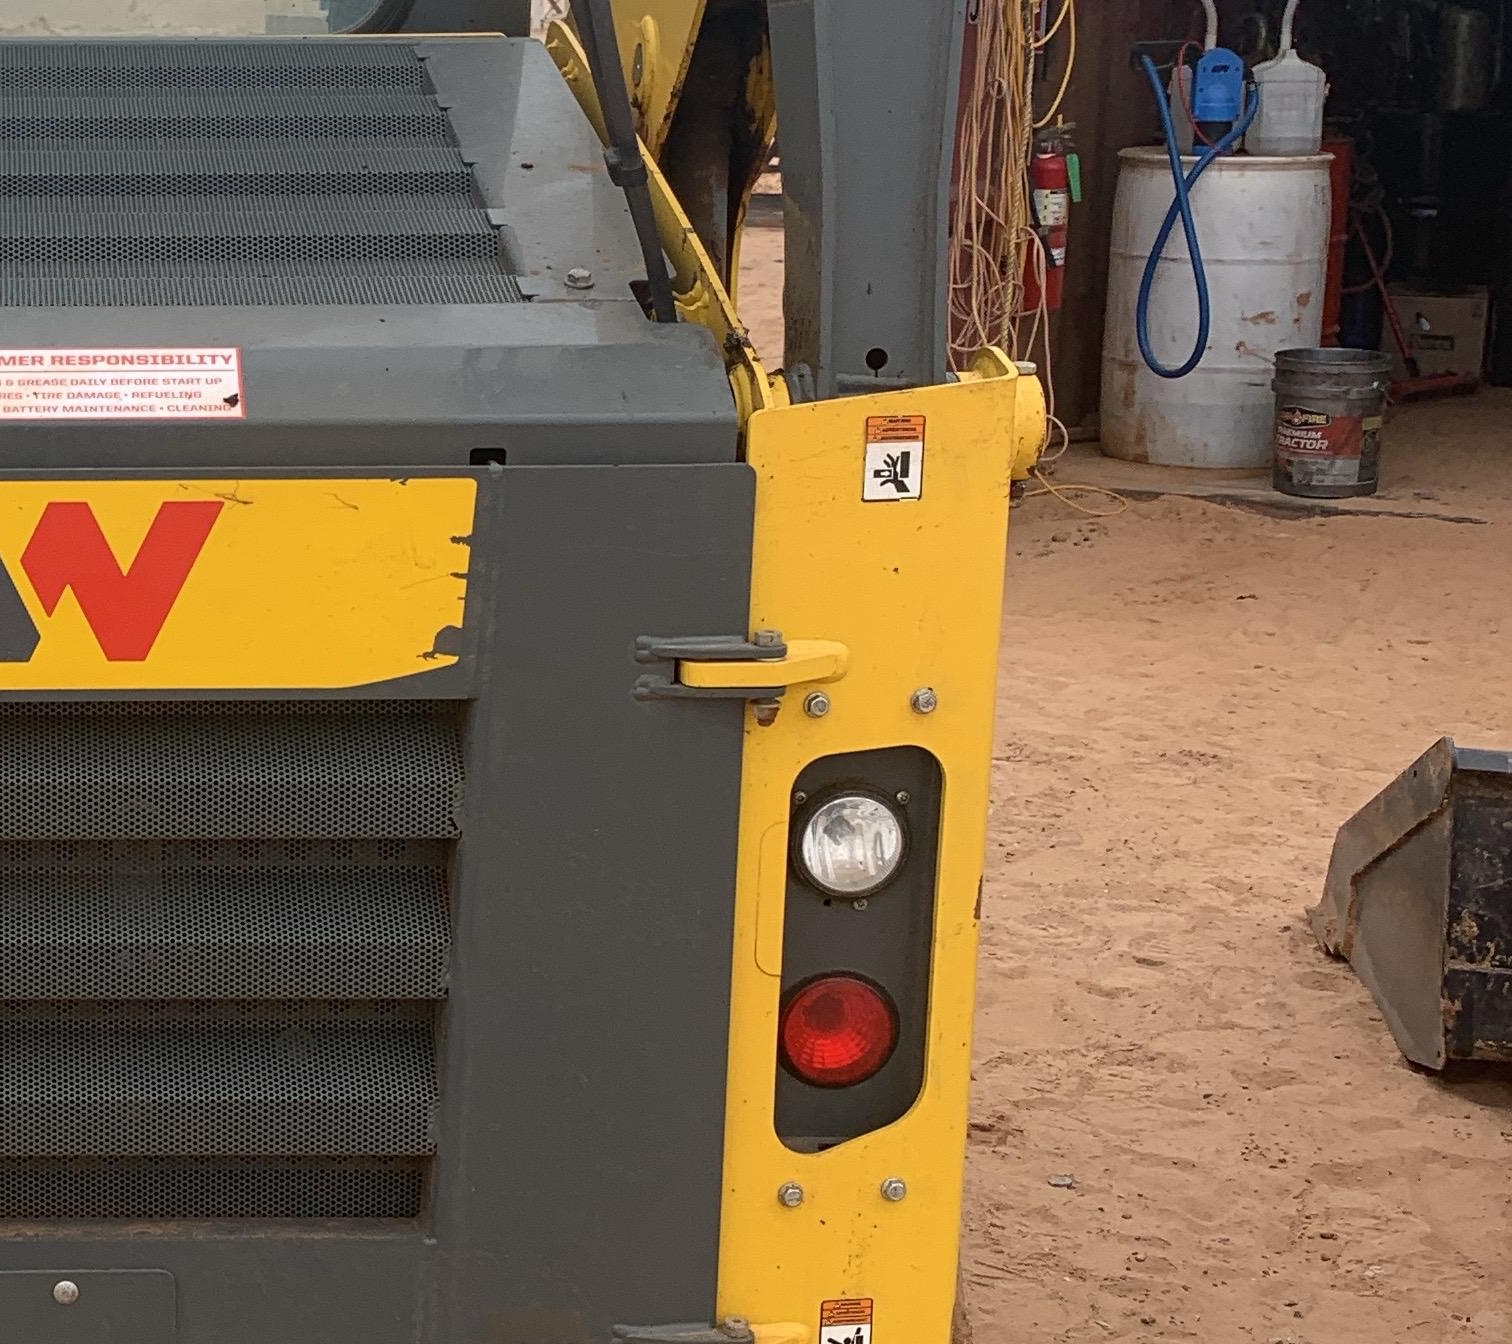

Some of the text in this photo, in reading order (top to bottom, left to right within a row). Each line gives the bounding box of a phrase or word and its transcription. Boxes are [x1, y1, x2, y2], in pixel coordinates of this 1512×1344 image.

[51, 354, 233, 366] RESPONSIBILITY
[18, 378, 66, 387] GREASE
[70, 378, 106, 387] DAILY
[110, 378, 157, 386] BEFORE
[162, 377, 201, 386] START
[205, 377, 223, 386] UP
[33, 391, 63, 400] TIRE
[67, 391, 121, 400] DAMAGE
[132, 391, 202, 400] REFUELING
[3, 405, 59, 413] BATTERY
[62, 404, 156, 413] MAINTENANCE
[167, 404, 232, 413] CLEANING
[1277, 435, 1329, 450] RACTOR
